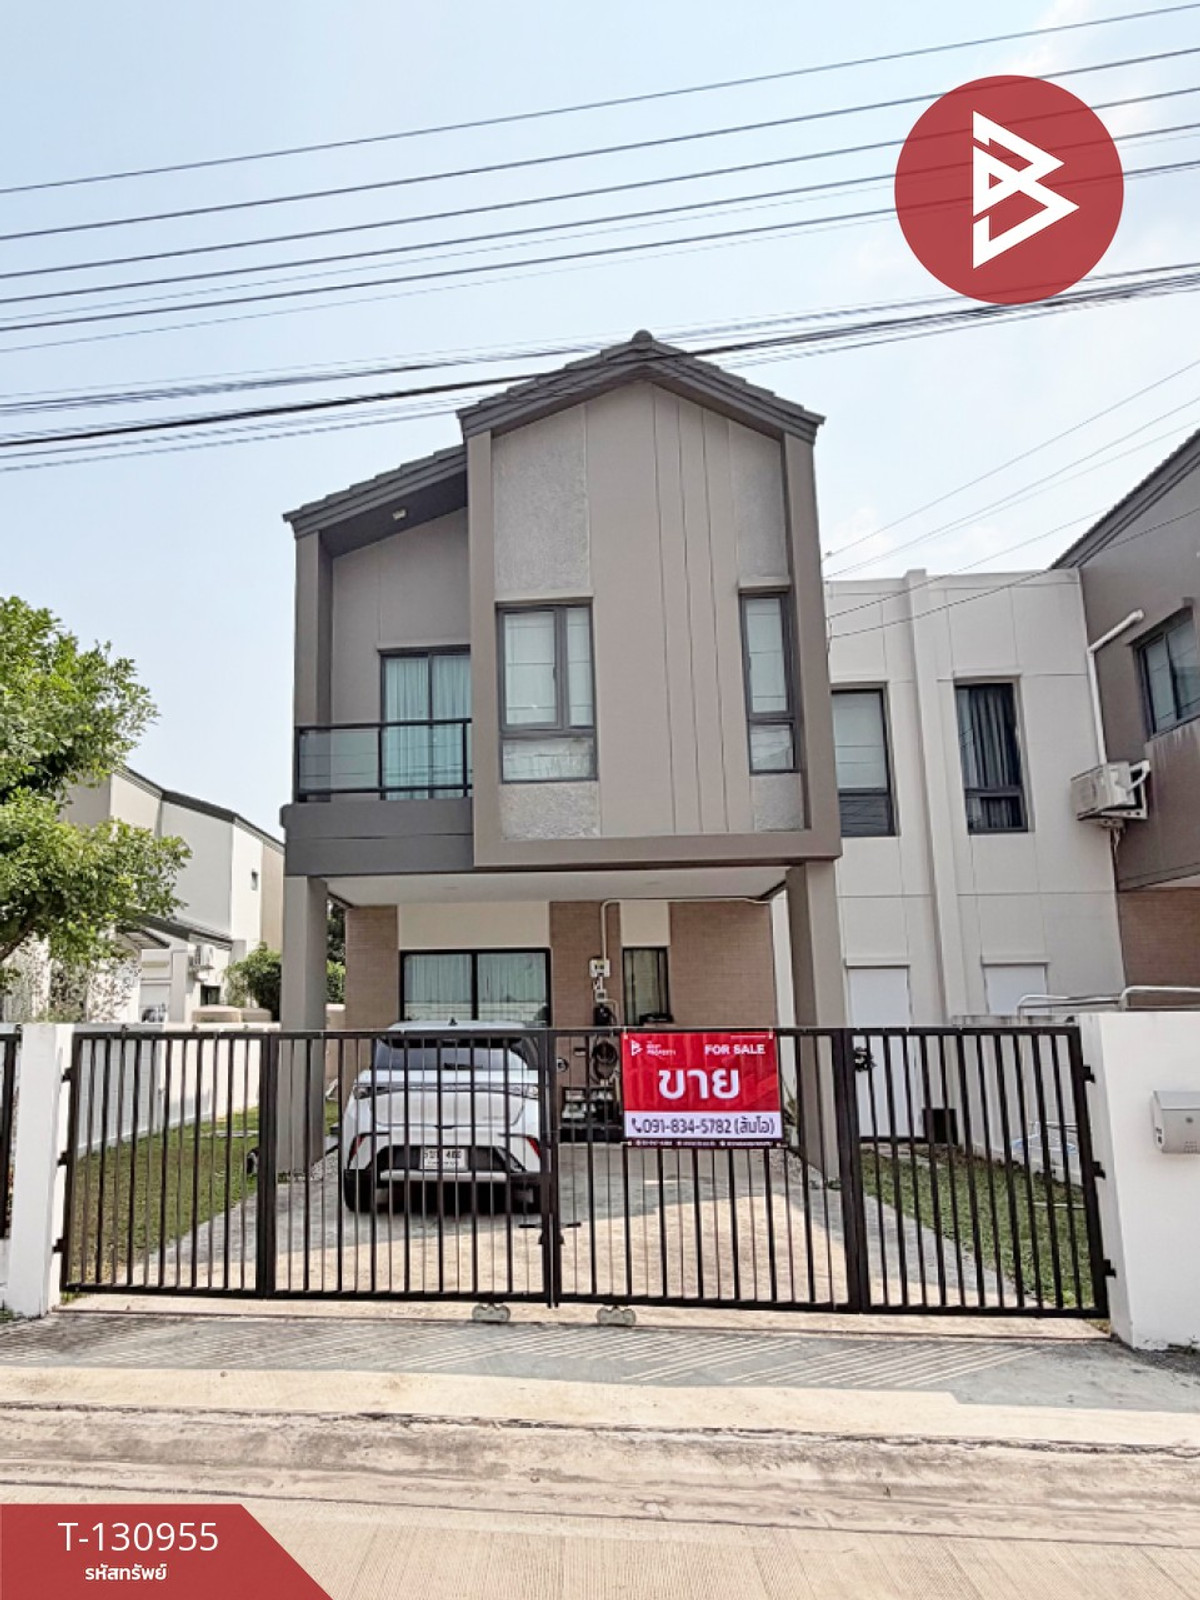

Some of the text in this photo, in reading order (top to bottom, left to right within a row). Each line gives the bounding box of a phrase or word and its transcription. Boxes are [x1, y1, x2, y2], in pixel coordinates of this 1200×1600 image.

[704, 1044, 765, 1055] FOR SALE
[658, 1069, 740, 1099] ขาย
[642, 1118, 732, 1134] 091-834-5782
